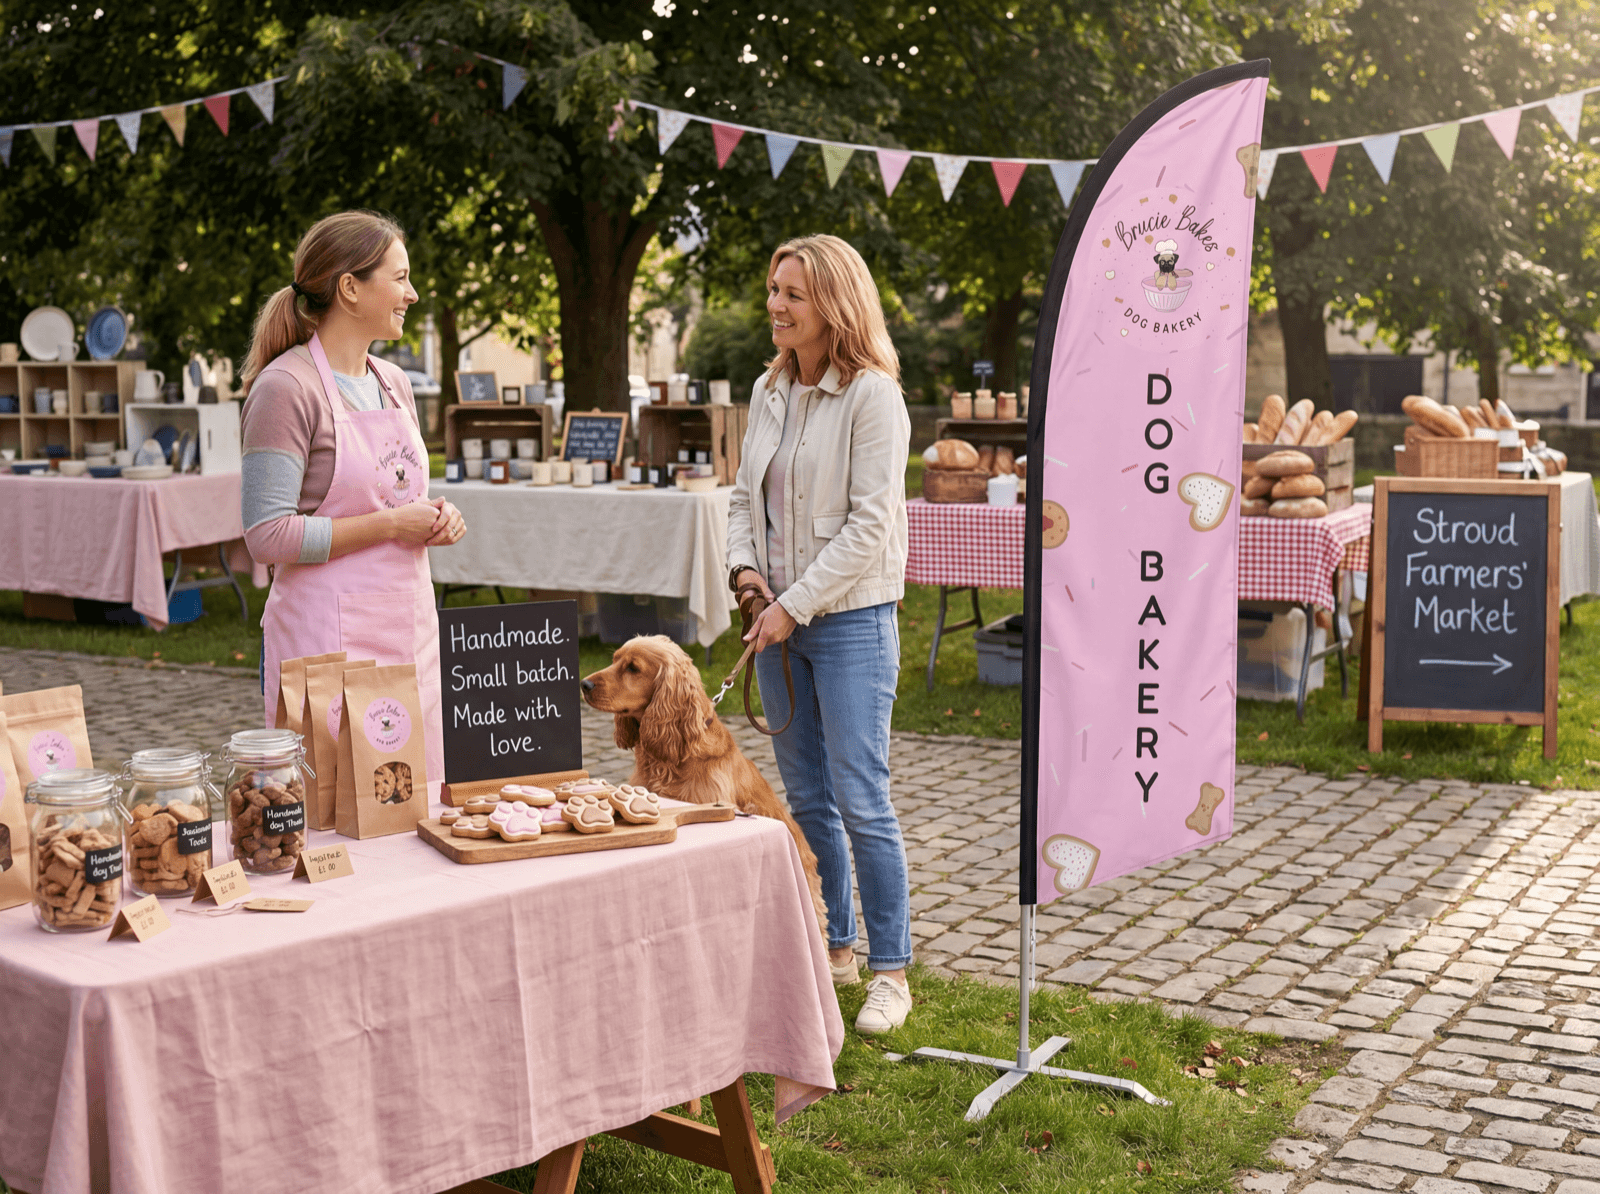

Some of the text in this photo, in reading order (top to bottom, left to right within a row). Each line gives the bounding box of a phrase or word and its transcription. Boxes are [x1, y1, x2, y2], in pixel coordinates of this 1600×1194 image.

[1115, 205, 1219, 252] Brucie Bakes
[1123, 307, 1202, 334] DOG BAKERY
[1413, 507, 1519, 546] Stroud
[1134, 373, 1173, 803] DOG BAKERY
[1405, 551, 1527, 590] Farmers'
[1414, 595, 1518, 635] Market
[451, 618, 570, 653] Handmade.
[451, 657, 574, 692] Small batch.
[453, 696, 562, 729] Made with
[490, 732, 542, 757] love.
